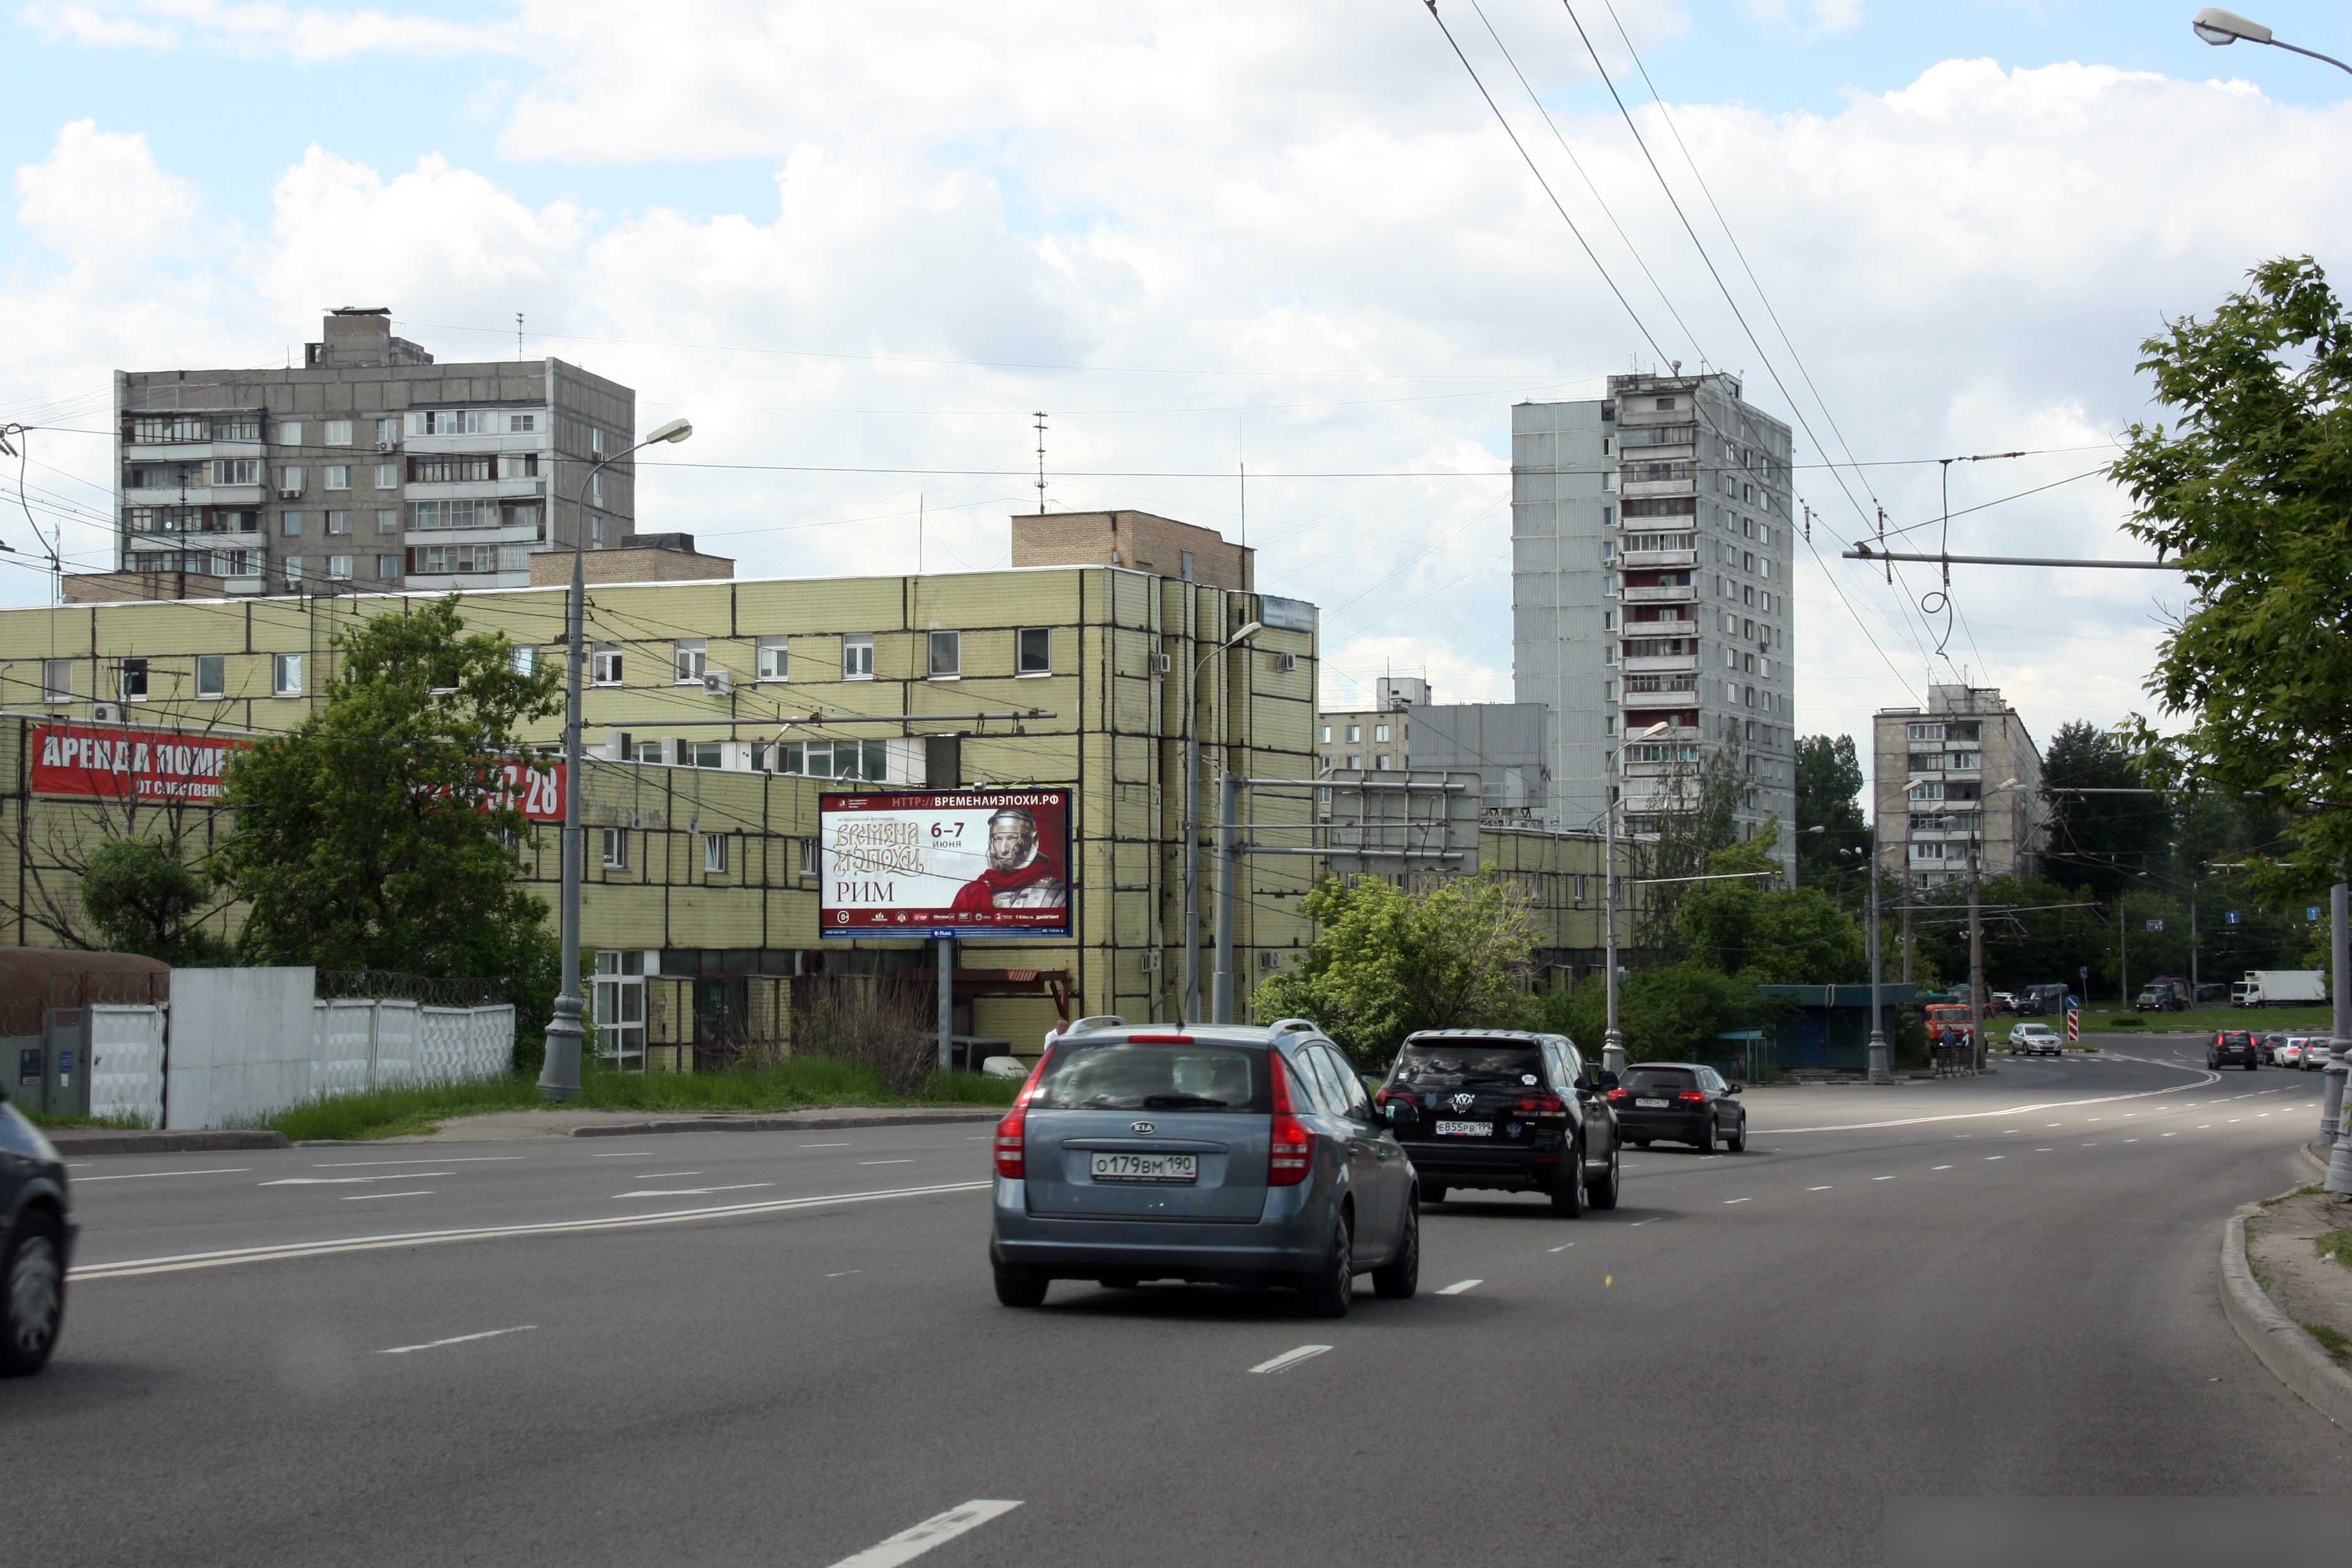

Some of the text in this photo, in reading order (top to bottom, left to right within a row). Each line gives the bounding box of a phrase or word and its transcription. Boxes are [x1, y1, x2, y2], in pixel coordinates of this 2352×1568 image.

[42, 736, 243, 778] АРЕНДА ПОМЕ
[836, 881, 895, 902] РИМ
[1167, 1156, 1192, 1170] 190
